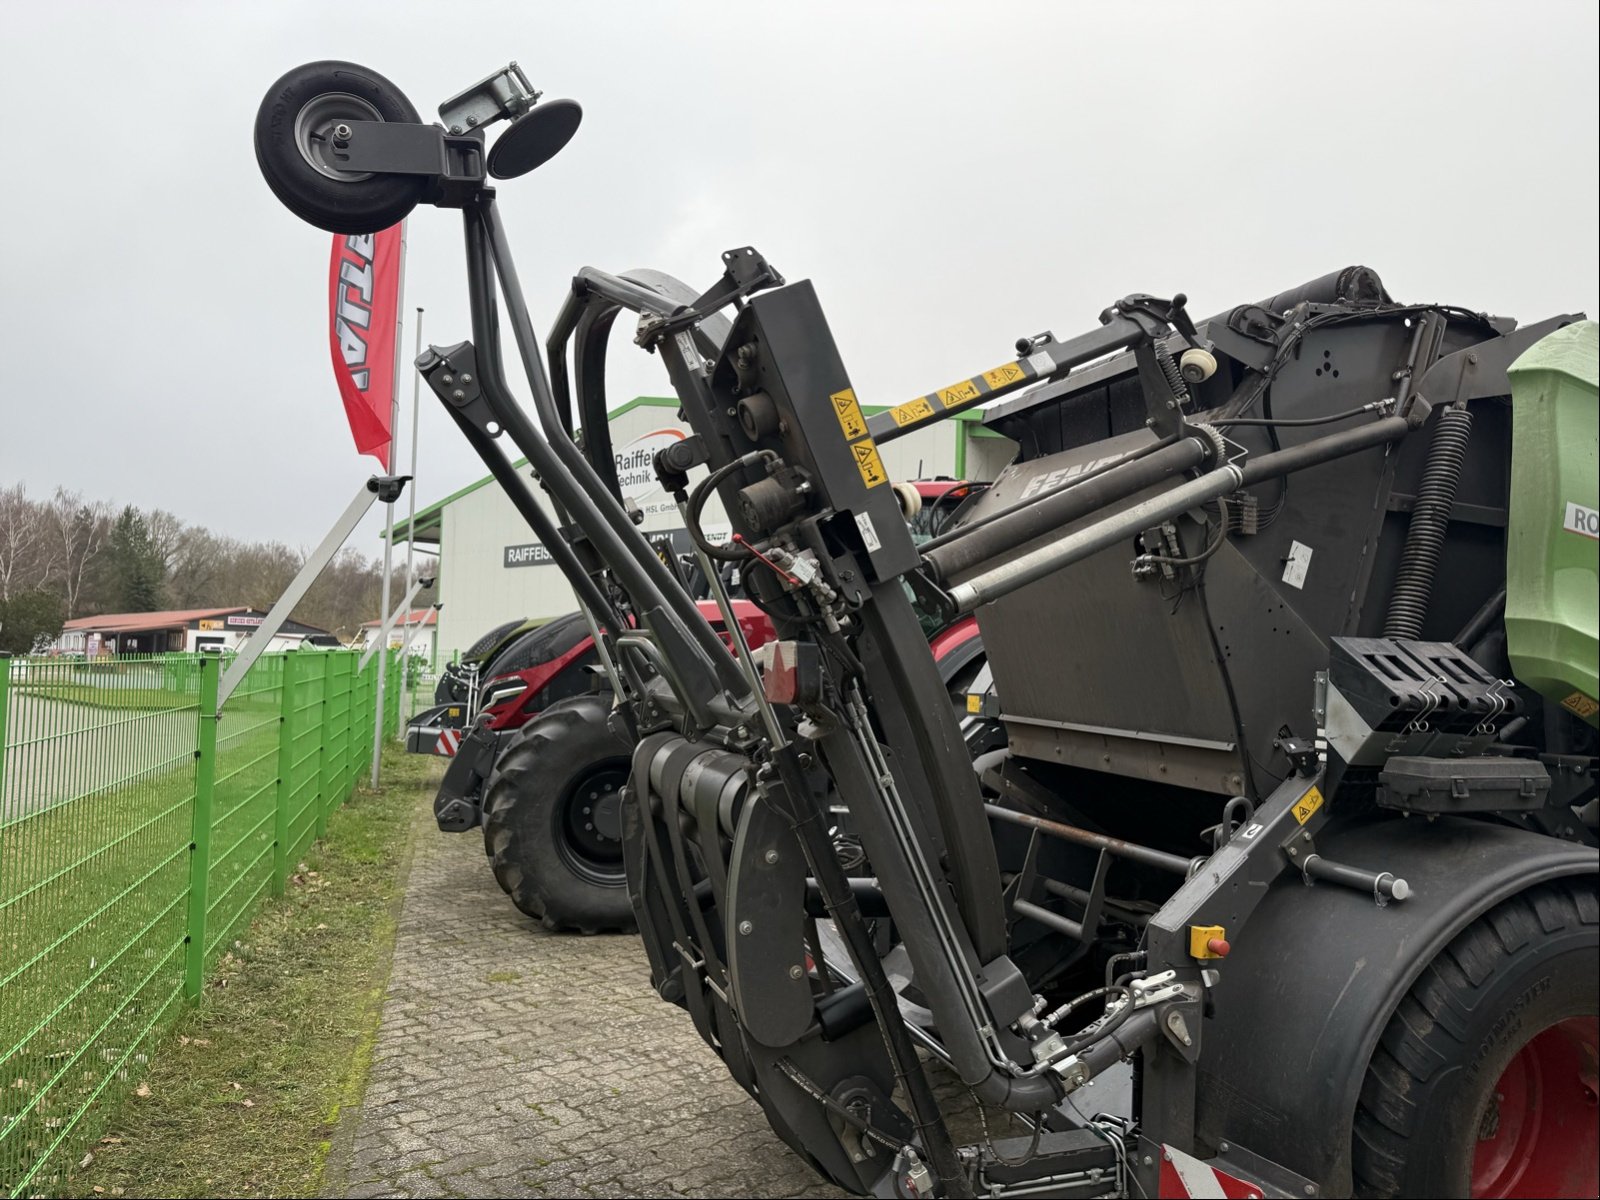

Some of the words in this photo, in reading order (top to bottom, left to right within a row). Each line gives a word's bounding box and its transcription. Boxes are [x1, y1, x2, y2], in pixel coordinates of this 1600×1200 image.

[615, 447, 656, 470] Raiffei
[645, 505, 658, 513] HSL
[508, 546, 552, 562] RAIFFEIS
